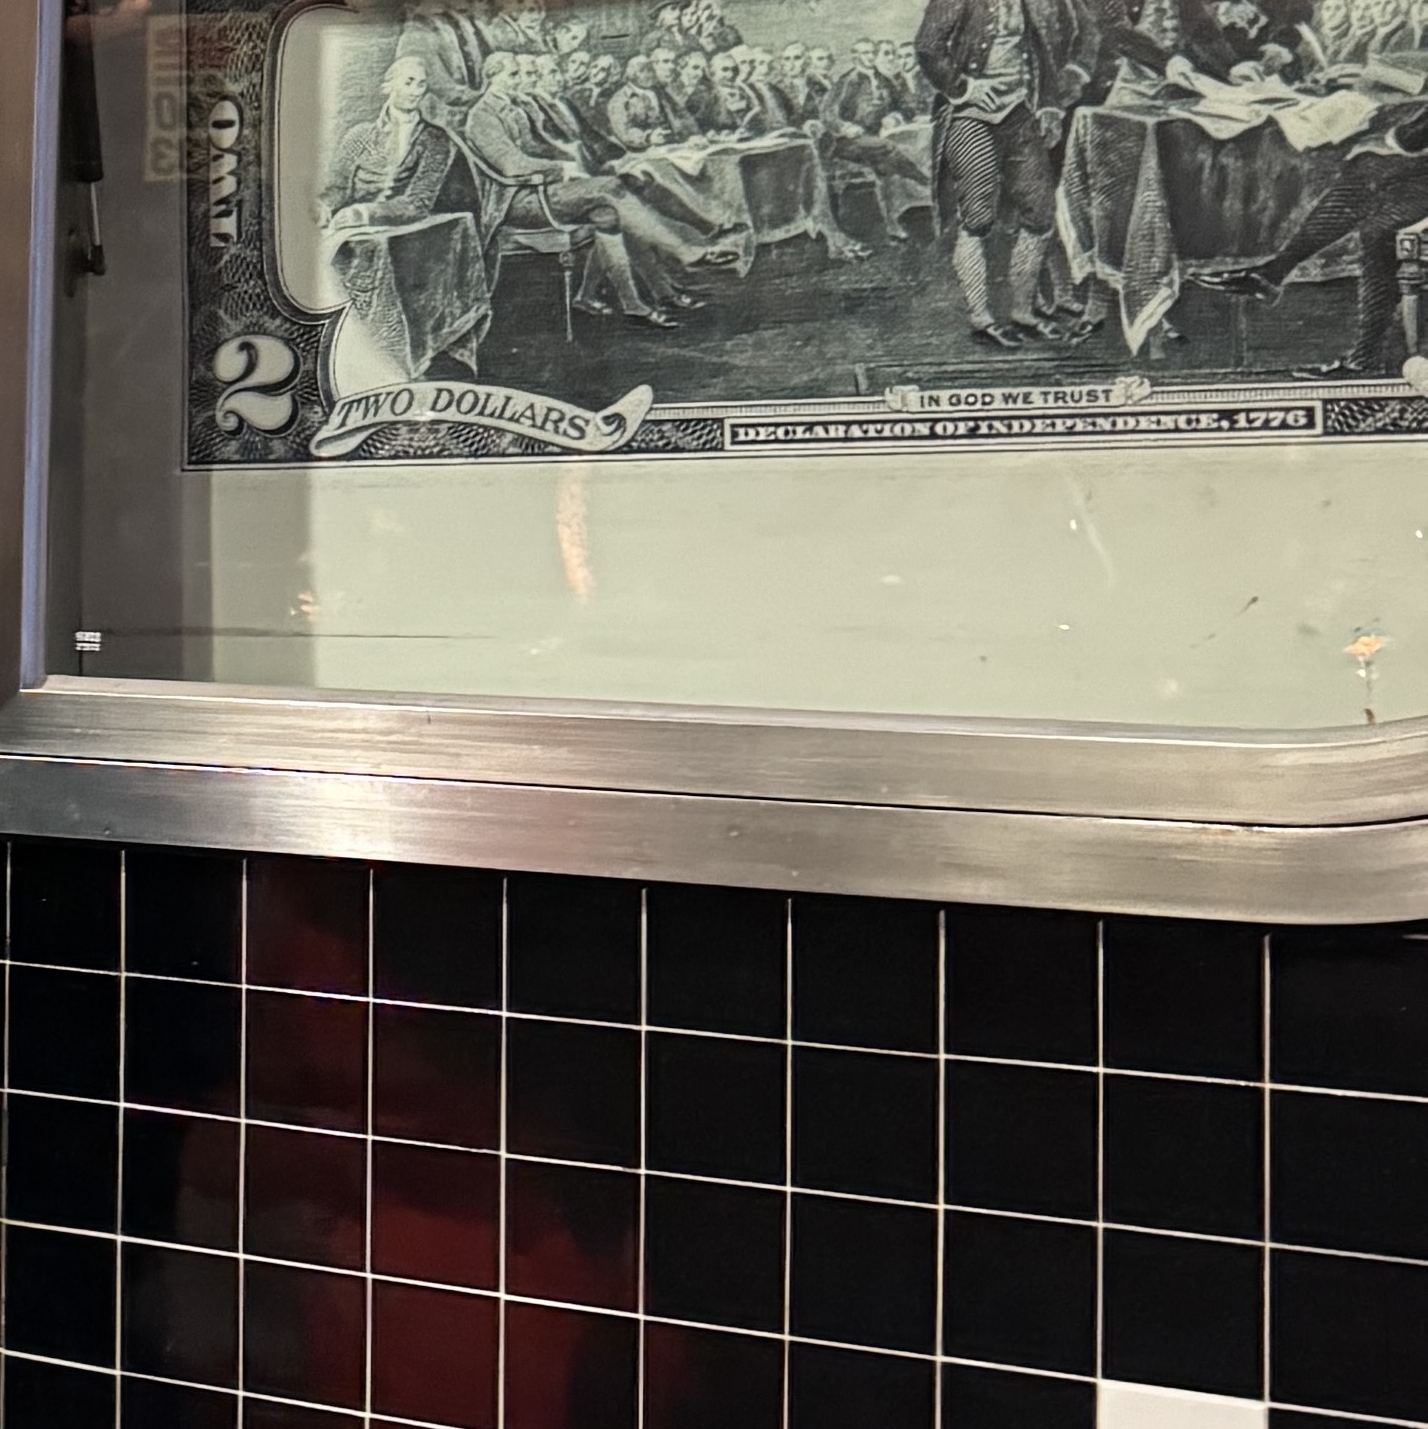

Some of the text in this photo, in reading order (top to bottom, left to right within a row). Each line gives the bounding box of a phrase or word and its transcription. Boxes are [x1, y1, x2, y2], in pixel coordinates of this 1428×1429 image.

[208, 98, 243, 248] TWO
[212, 334, 300, 436] 2
[919, 388, 1114, 409] IN GOD WE TRUST
[337, 387, 591, 441] TWO DOLLARS
[735, 422, 932, 441] DECLARATION
[933, 421, 978, 438] OF
[1232, 410, 1308, 430] 1776
